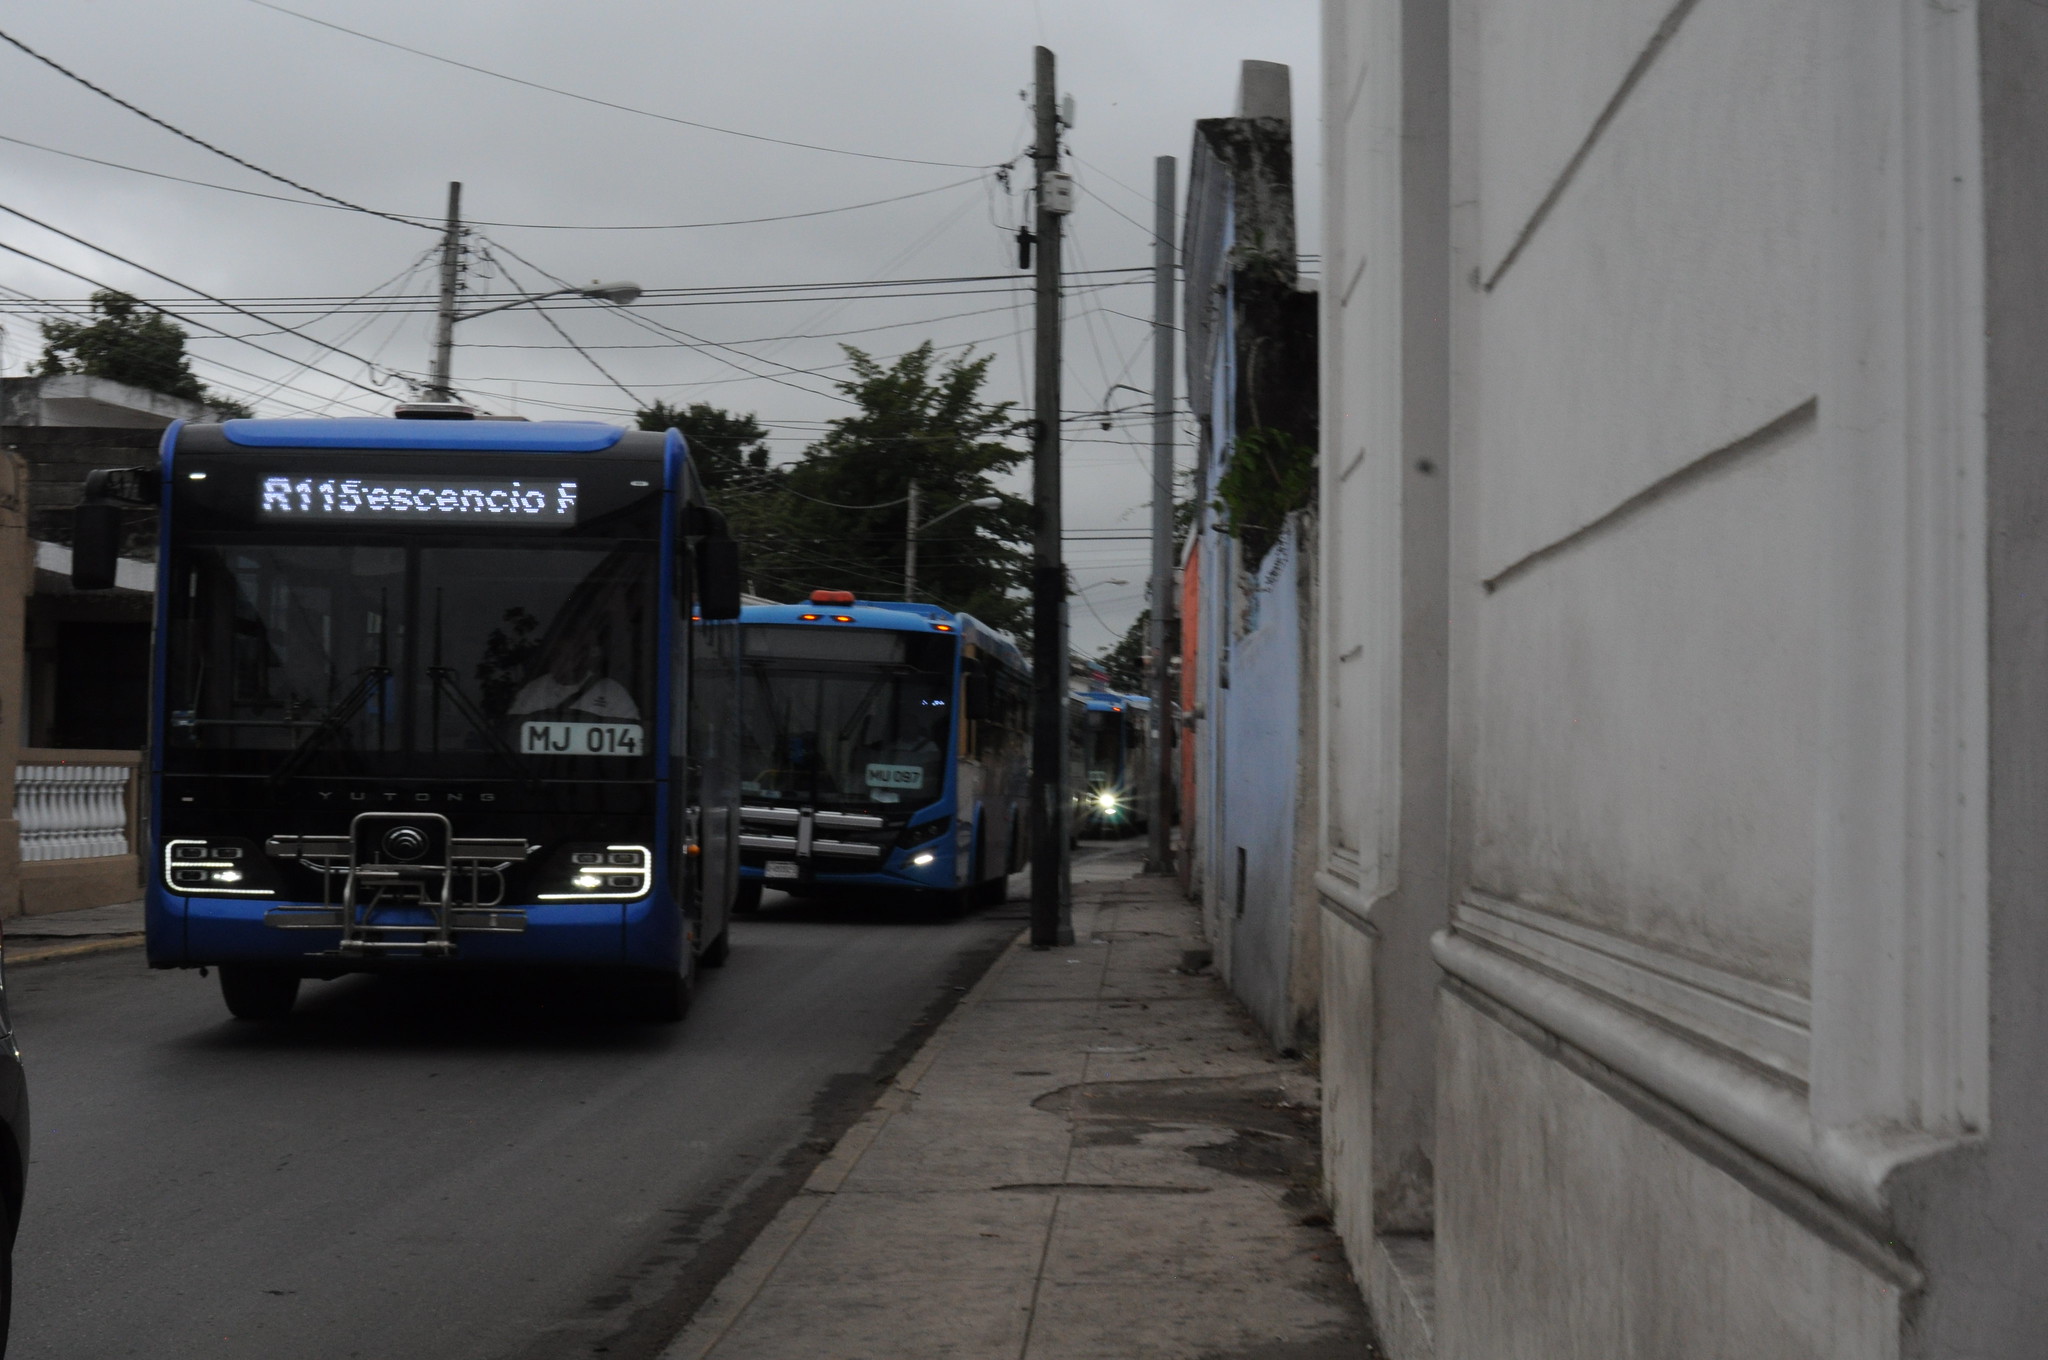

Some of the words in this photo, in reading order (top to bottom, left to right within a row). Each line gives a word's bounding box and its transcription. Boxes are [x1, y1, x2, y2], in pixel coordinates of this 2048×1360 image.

[528, 726, 571, 752] MJ
[586, 727, 636, 753] 014
[317, 791, 496, 802] YUTONG
